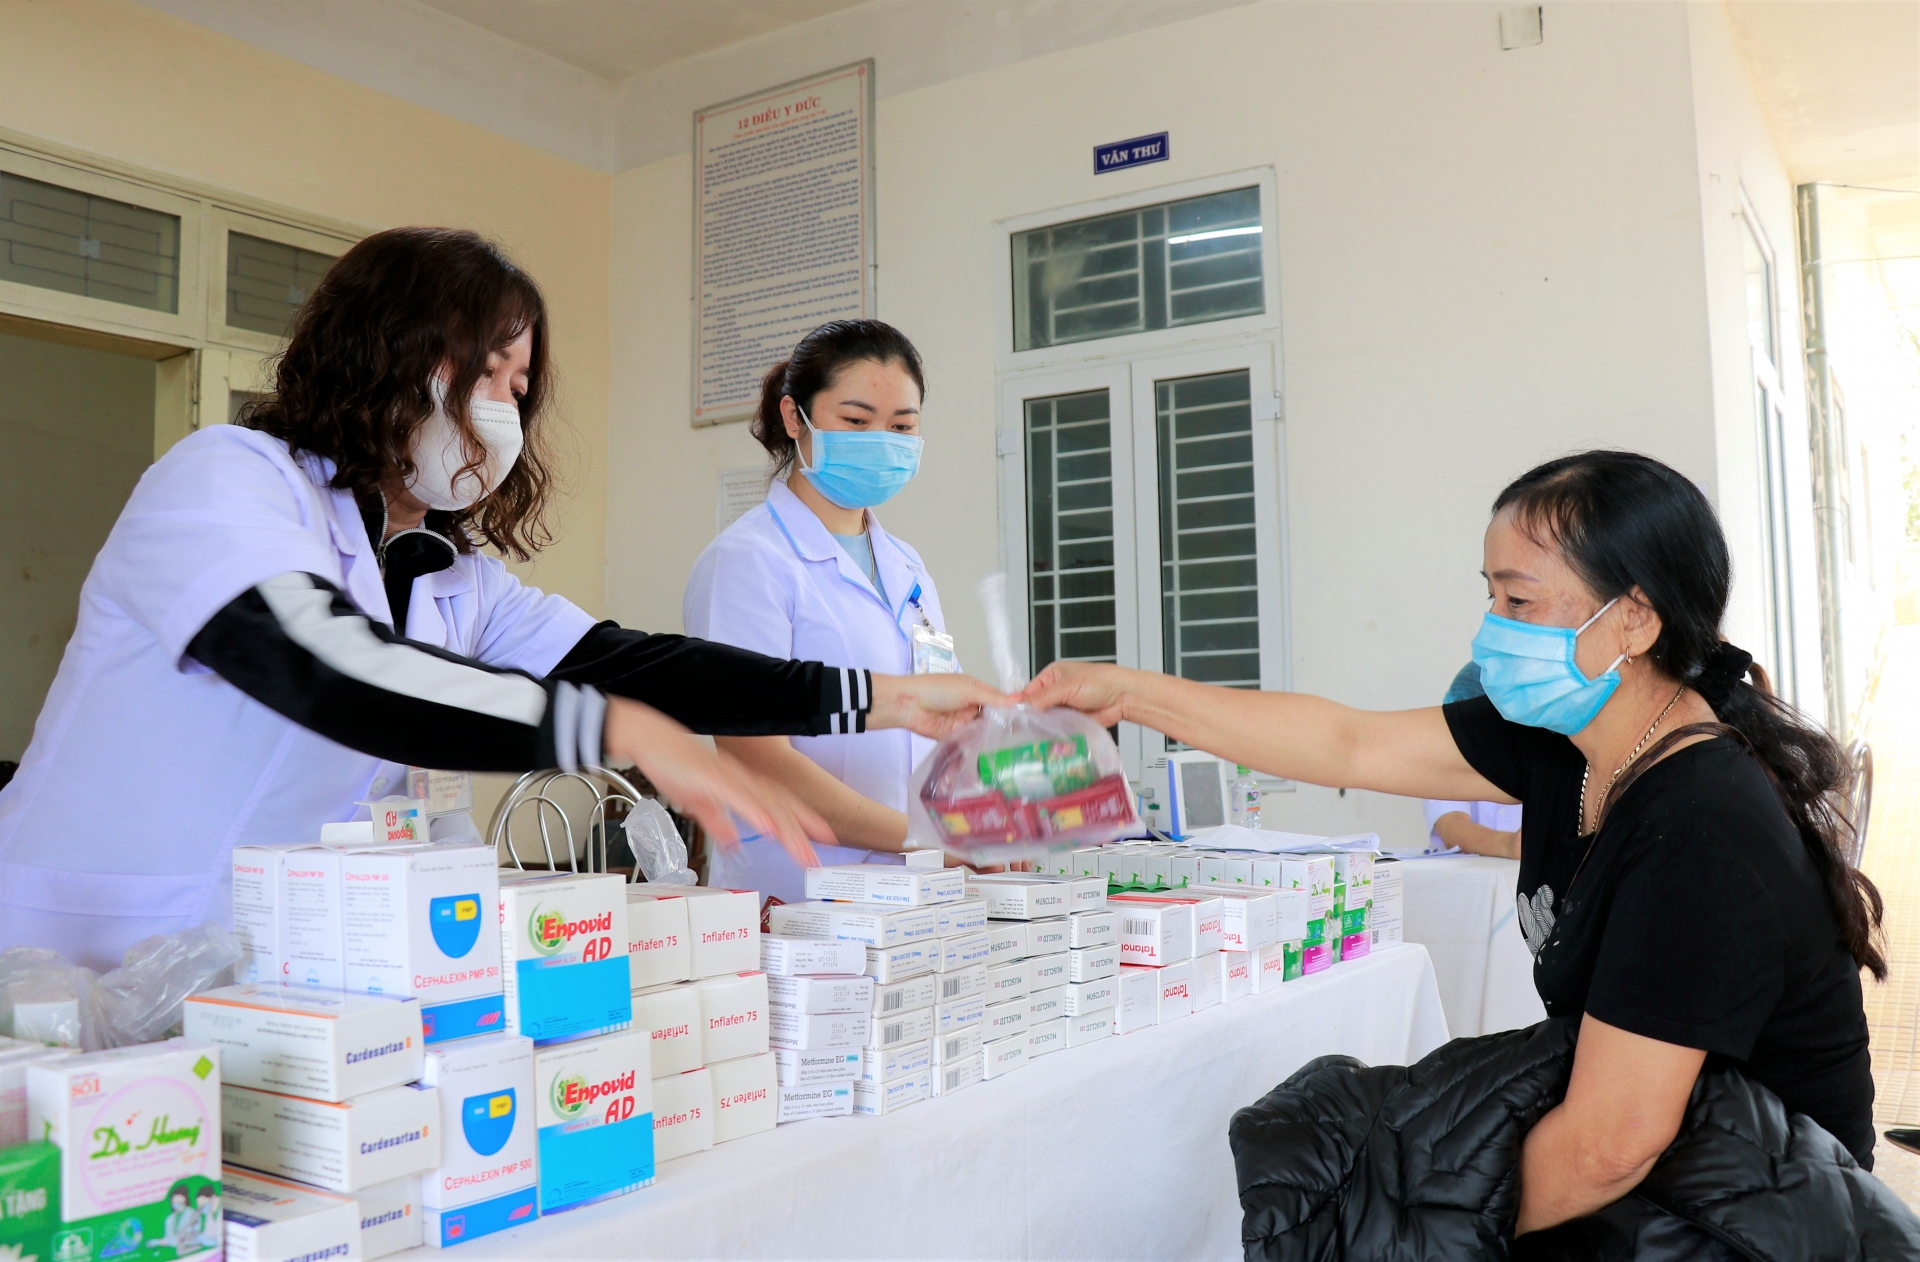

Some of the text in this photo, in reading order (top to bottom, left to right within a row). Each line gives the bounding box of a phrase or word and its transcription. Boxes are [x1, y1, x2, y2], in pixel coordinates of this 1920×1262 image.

[738, 118, 749, 130] 12
[784, 105, 792, 116] Y
[1101, 141, 1161, 165] VĂN THƯ
[1036, 897, 1056, 905] MUSCLID
[543, 911, 612, 942] Enpovid
[1200, 919, 1222, 935] Tatanol
[702, 928, 748, 943] Inflafen 75
[628, 935, 678, 953] Inflafen 75
[991, 941, 1011, 952] MUSCLID
[1122, 944, 1156, 957] Tatanol
[469, 968, 485, 980] PMP
[486, 966, 499, 977] 500
[1229, 966, 1248, 981] Tatanol
[1264, 958, 1281, 973] Tatanol
[1087, 990, 1105, 1001] MUSCLID
[1164, 984, 1188, 1000] Tatanol
[710, 1010, 758, 1029] Inflafen 75
[652, 1024, 689, 1040] Inflafen
[346, 1036, 412, 1064] Cardesartan 8
[801, 1057, 834, 1066] Metformine
[836, 1055, 845, 1064] EG
[564, 1069, 635, 1105] Enpovid
[720, 1088, 767, 1109] Inflafen 75
[784, 1091, 821, 1101] Metformine
[652, 1108, 701, 1130] Inflafen 75
[361, 1126, 429, 1155] Cardesartan 8
[444, 1158, 533, 1191] CEPHALEXIN PMP 500
[360, 1204, 411, 1229] desartan 8
